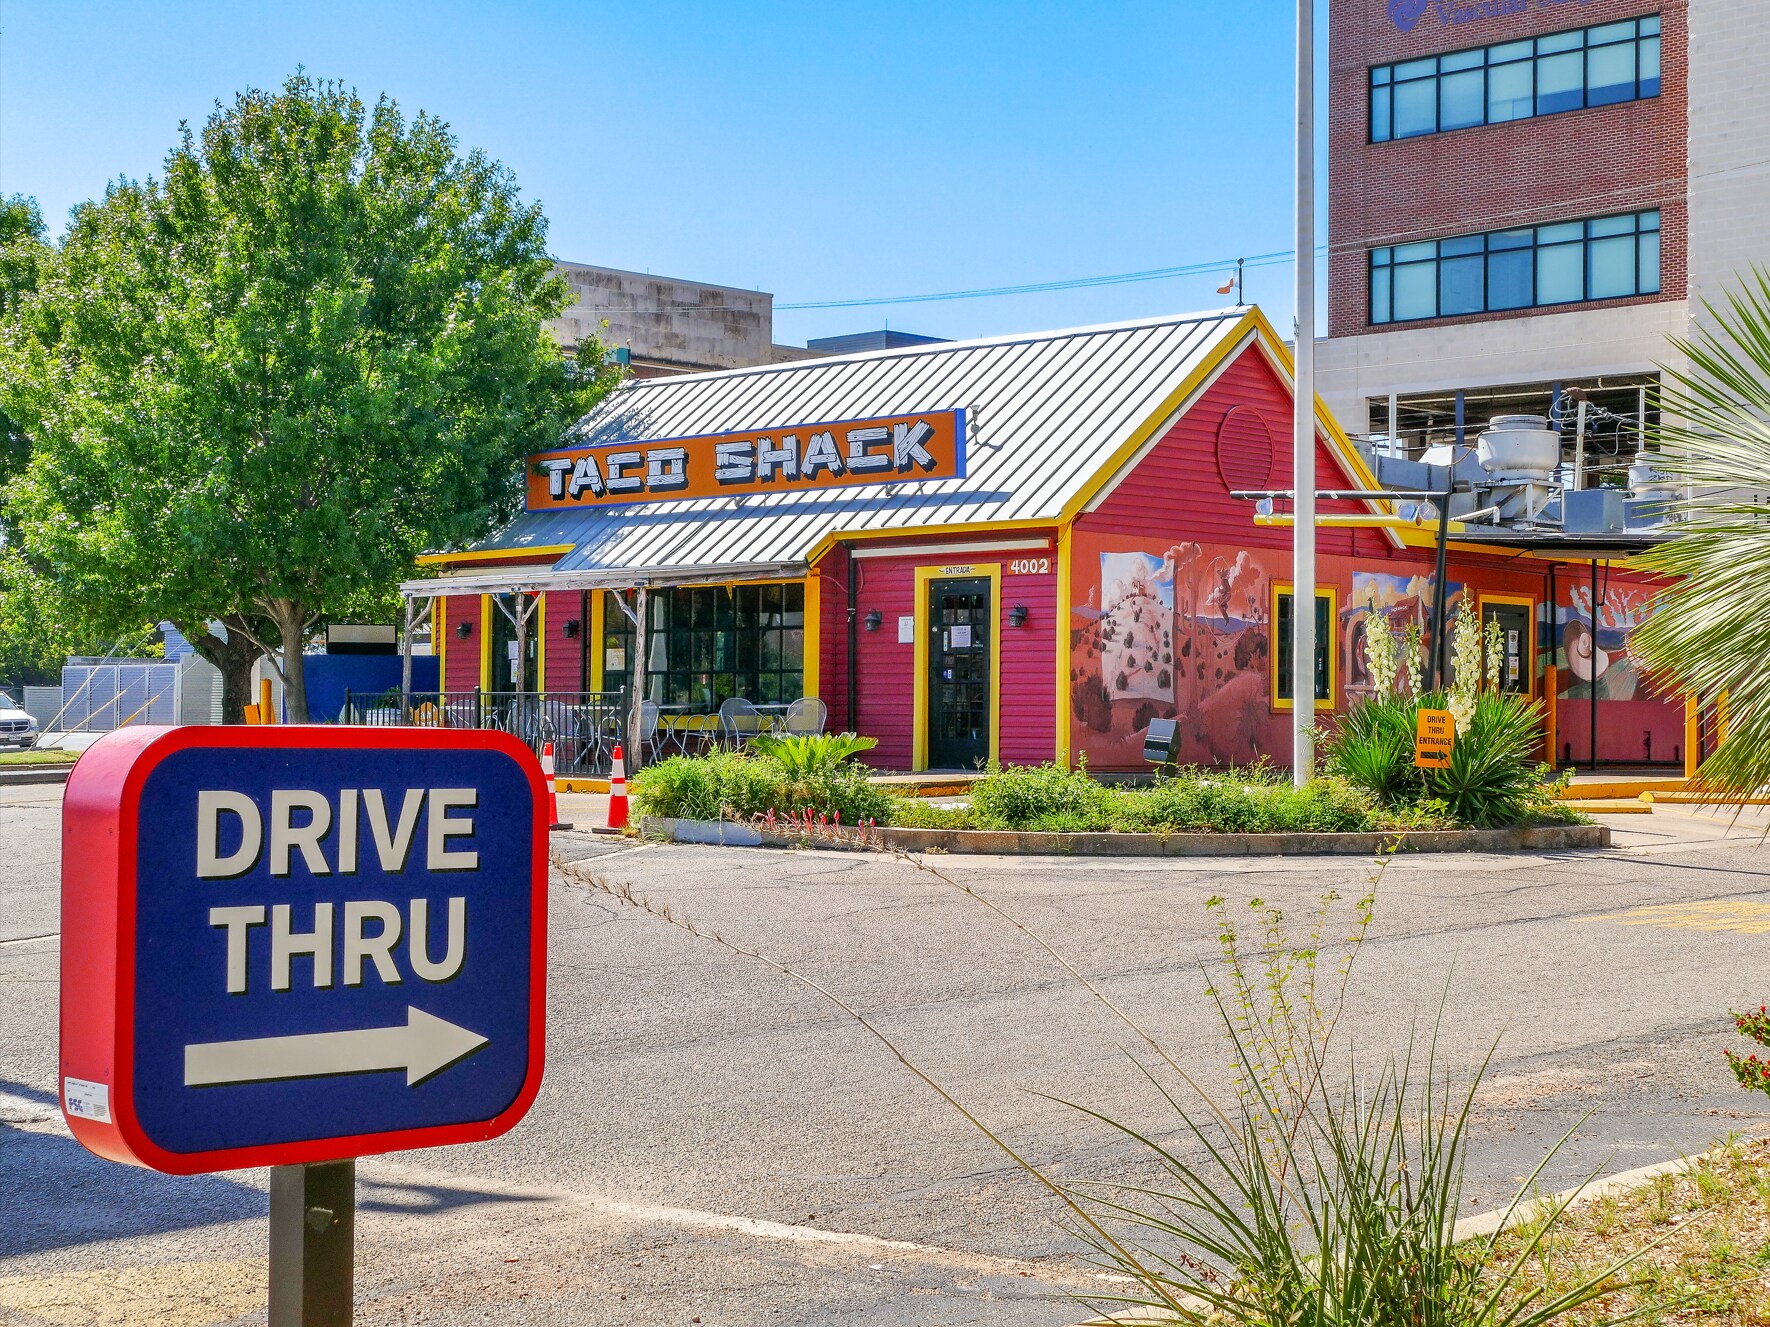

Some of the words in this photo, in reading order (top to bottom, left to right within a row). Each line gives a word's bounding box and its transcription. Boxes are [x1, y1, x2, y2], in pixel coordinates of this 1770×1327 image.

[1436, 0, 1527, 26] Vascular
[540, 446, 688, 499] TACO
[714, 419, 936, 481] SHACK
[945, 566, 971, 575] ENTRADA
[1010, 558, 1049, 574] 4002
[1427, 715, 1446, 724] DRIVE
[1428, 726, 1445, 735] THRU
[1419, 736, 1452, 746] ENTRANCE
[196, 788, 479, 880] DRIVE
[209, 897, 467, 996] THRU
